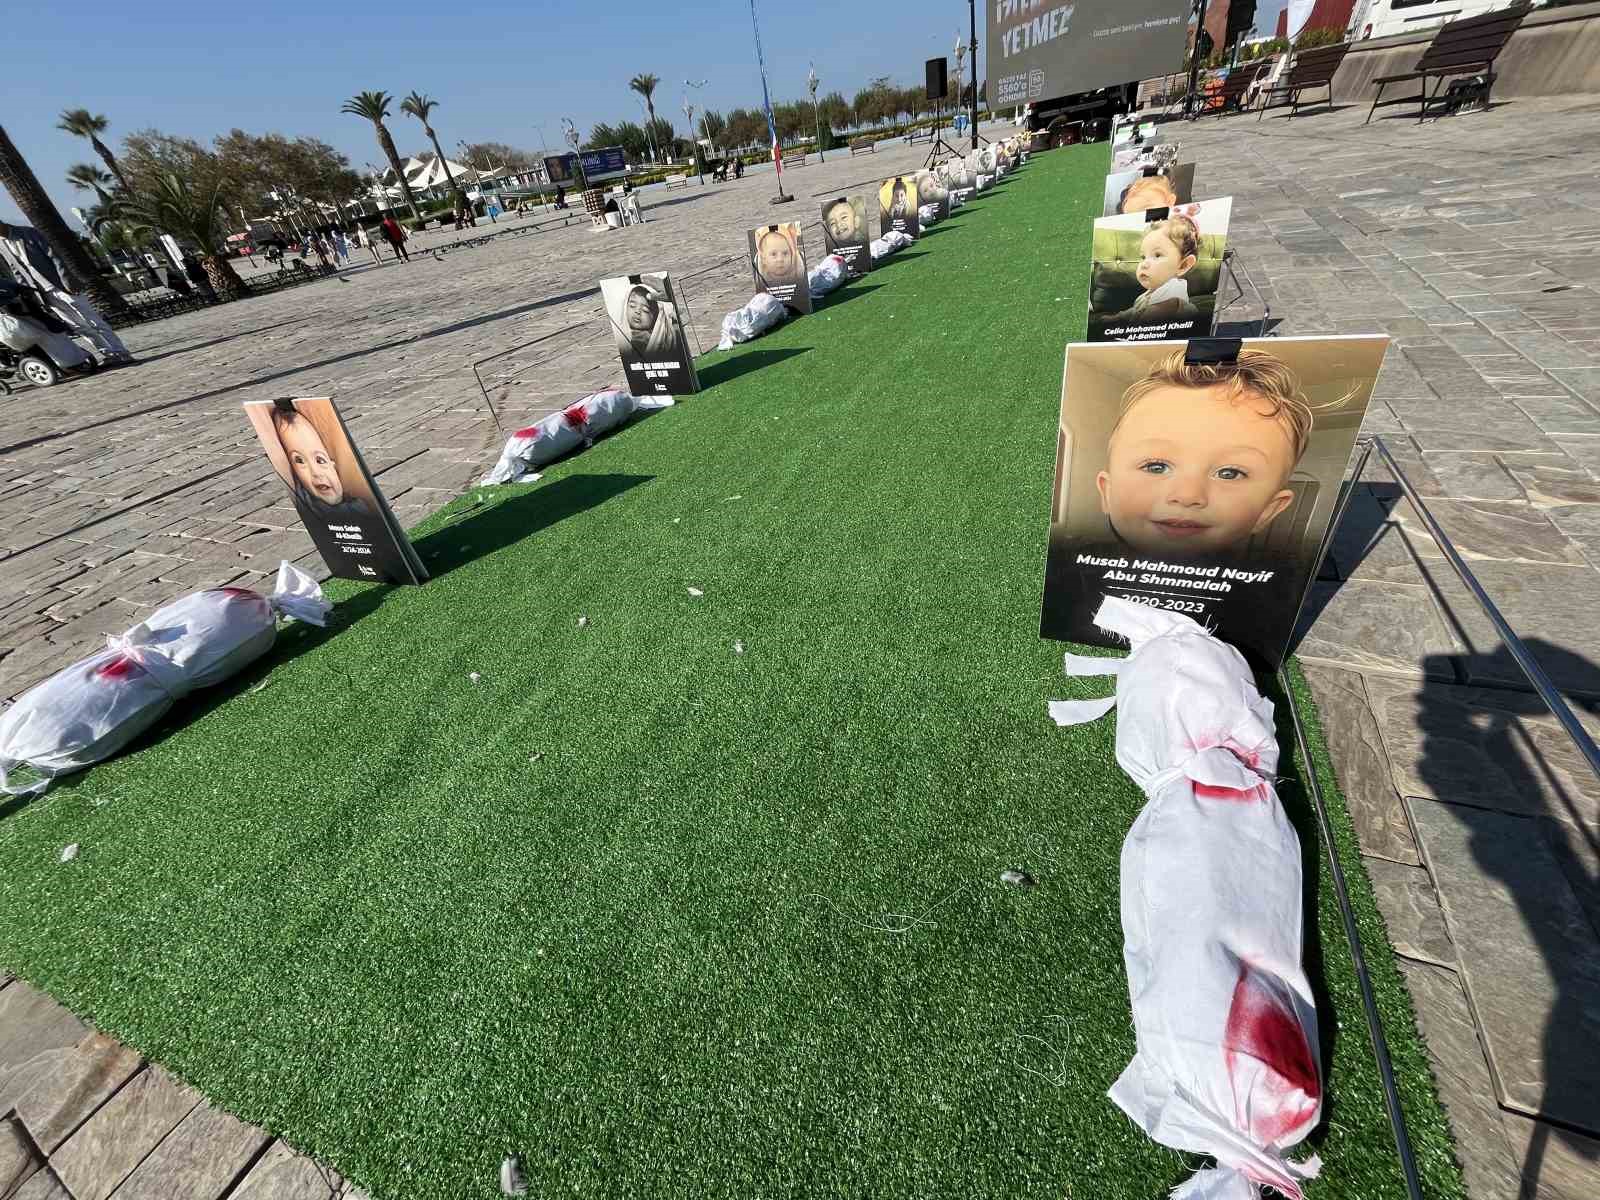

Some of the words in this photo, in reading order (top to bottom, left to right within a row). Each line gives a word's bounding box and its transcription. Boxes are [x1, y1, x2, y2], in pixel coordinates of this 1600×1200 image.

[1002, 4, 1075, 58] YETMEZ
[1075, 553, 1130, 569] Musab
[1132, 558, 1220, 580] Mahmoud
[1221, 566, 1275, 584] Nayif
[1102, 569, 1138, 583] Abu
[1139, 573, 1232, 593] Shmmalah
